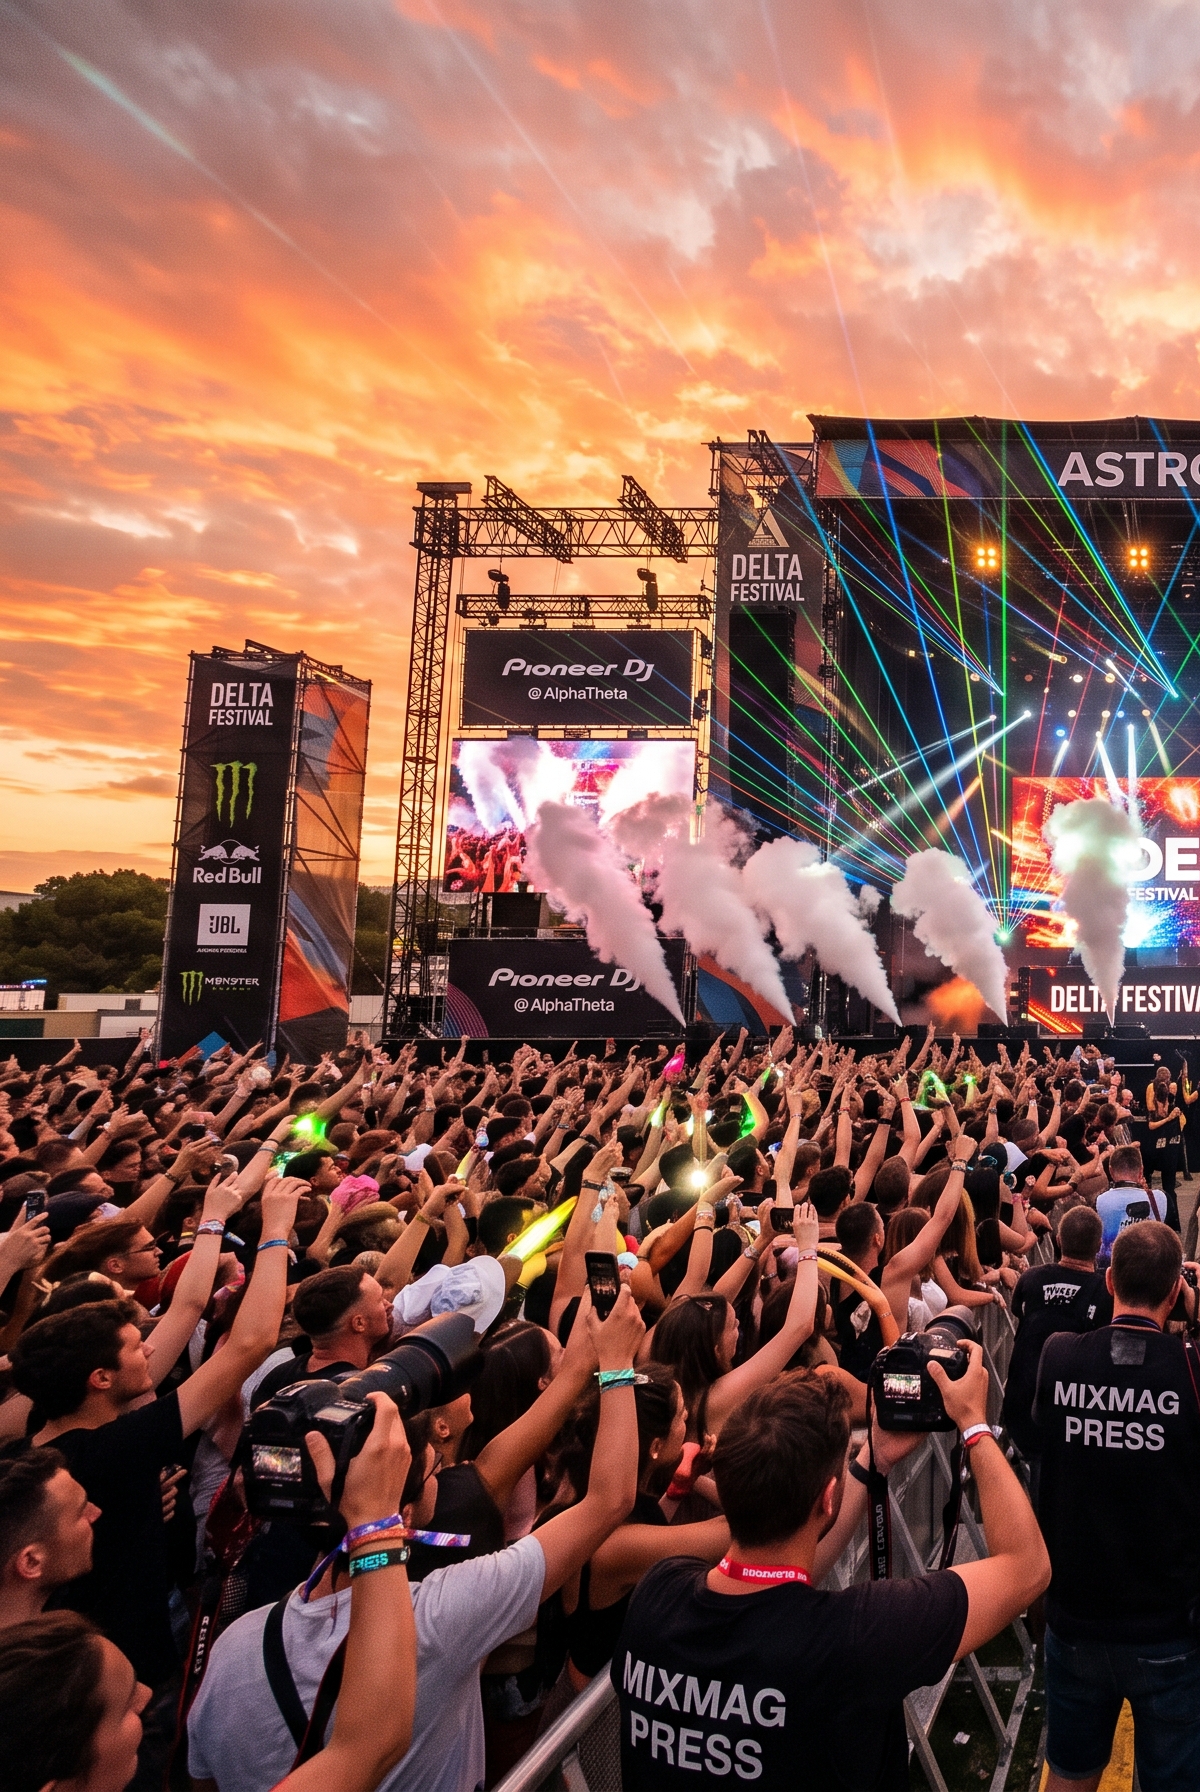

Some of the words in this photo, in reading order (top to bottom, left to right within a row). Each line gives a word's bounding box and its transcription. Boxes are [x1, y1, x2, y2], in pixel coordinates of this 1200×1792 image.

[732, 554, 803, 581] DELTA
[730, 583, 805, 602] FESTIVAL
[502, 658, 618, 676] Pioneer
[210, 683, 274, 707] DELTA
[208, 709, 274, 726] FESTIVAL
[192, 867, 227, 883] Red
[228, 867, 262, 884] Bull
[1126, 887, 1199, 901] FESTIVAL
[209, 916, 240, 934] JBL
[205, 977, 260, 986] MONSTER
[488, 967, 605, 987] Pioneer
[1054, 1380, 1180, 1415] MIXMAG
[1065, 1415, 1165, 1451] PRESS
[623, 1650, 787, 1728] MIXMAG
[630, 1709, 763, 1780] PRESS
